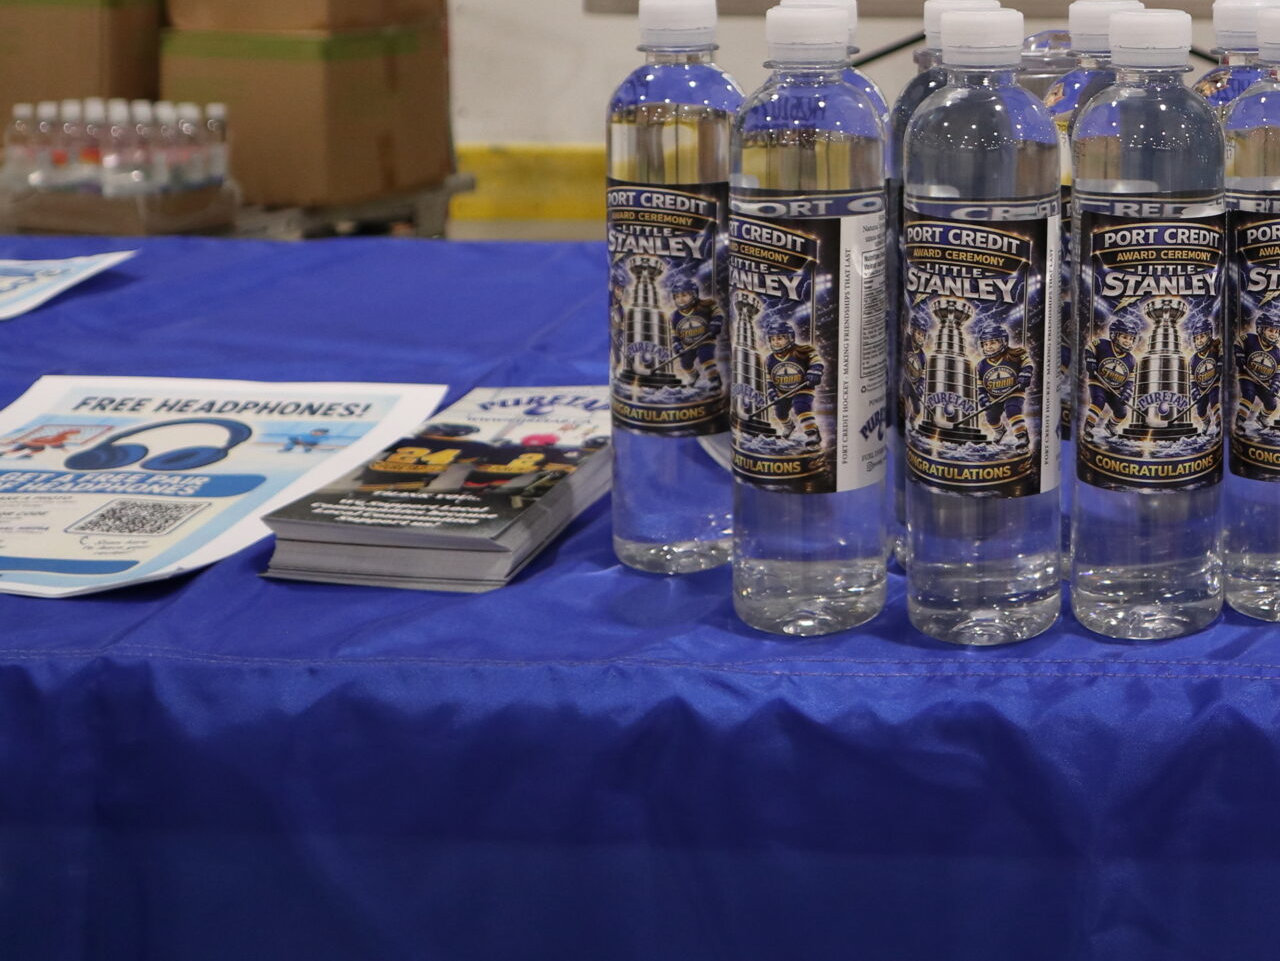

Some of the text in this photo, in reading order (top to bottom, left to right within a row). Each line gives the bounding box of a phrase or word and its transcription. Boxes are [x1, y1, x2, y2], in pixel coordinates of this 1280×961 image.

[640, 193, 707, 214] CREDIT
[638, 212, 693, 226] CEREMONY
[622, 225, 672, 237] LITTLE
[741, 223, 805, 252] CREDIT
[907, 226, 943, 243] PORT
[948, 229, 1020, 254] CREDIT
[1104, 228, 1220, 248] PORT CREDIT
[608, 230, 704, 259] STANLEY
[740, 244, 790, 264] CEREMONY
[913, 248, 1005, 267] AWARD CEREMONY
[1116, 250, 1211, 261] AWARD CEREMONY
[926, 263, 983, 278] LITTLE
[1137, 265, 1196, 275] LITTLE
[907, 266, 1017, 304] STANLEY
[1102, 272, 1217, 296] STANLEY
[72, 396, 373, 418] FREE HEADPHONES!
[1095, 454, 1214, 477] CONGRATULATIONS
[17, 482, 200, 495] HEADPHONES
[76, 473, 145, 484] FREE
[146, 475, 210, 486] PAIR
